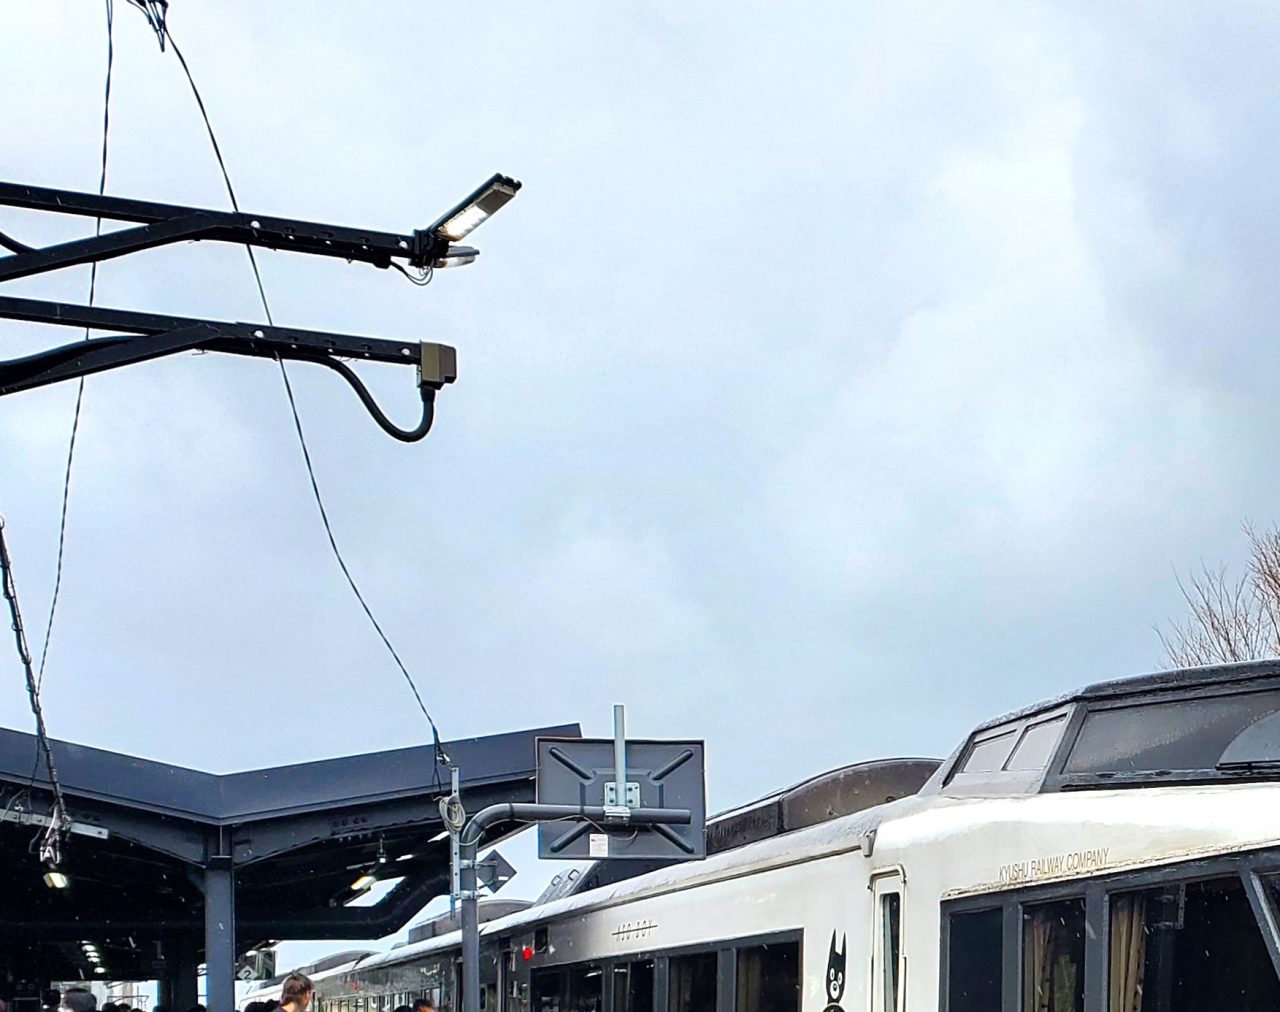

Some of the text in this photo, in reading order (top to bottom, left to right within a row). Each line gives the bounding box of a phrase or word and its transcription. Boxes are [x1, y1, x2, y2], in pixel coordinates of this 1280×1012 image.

[999, 848, 1109, 881] KYUSHU RAILWAY COMPANY
[243, 969, 252, 980] 2
